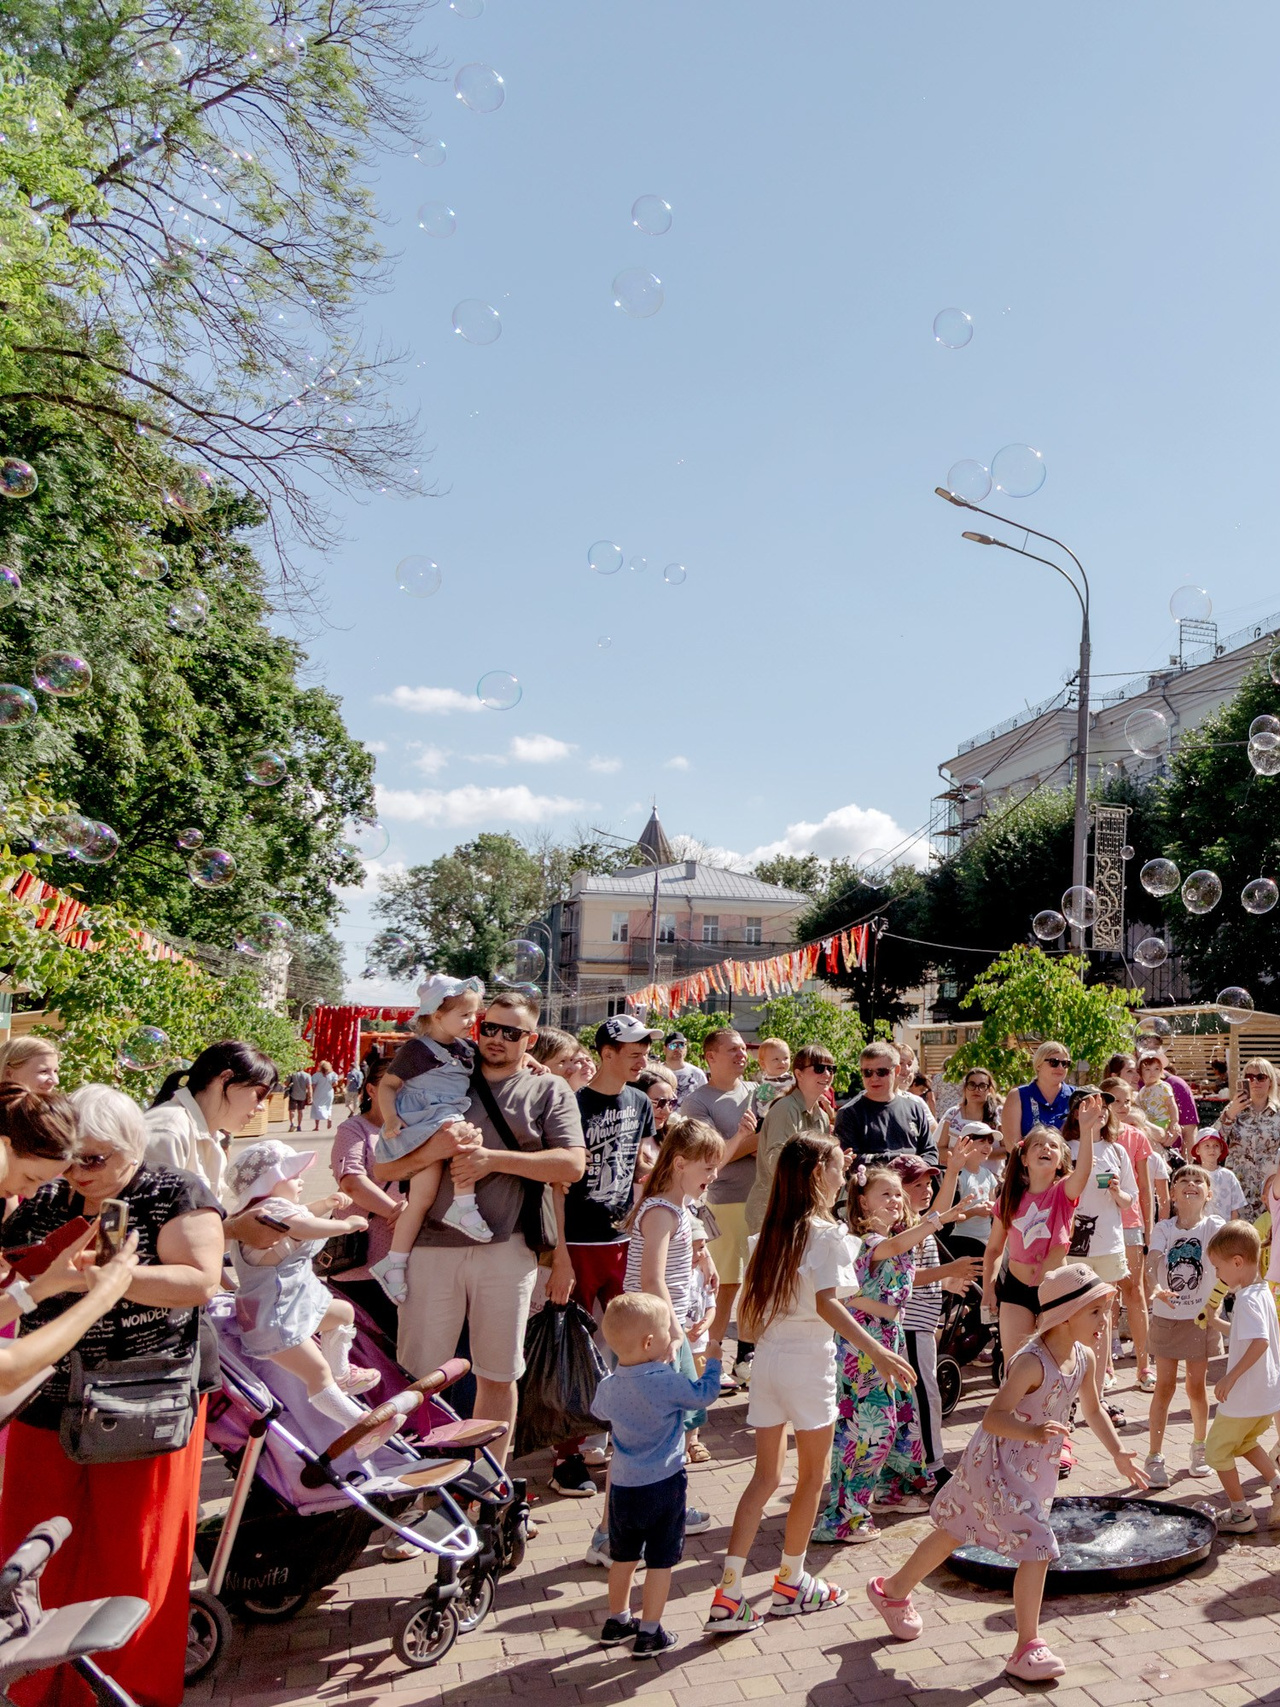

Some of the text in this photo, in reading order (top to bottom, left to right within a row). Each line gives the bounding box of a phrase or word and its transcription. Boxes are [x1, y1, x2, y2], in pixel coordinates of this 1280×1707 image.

[599, 1106, 638, 1127] Atlantic
[586, 1119, 640, 1146] Navigation
[121, 1308, 170, 1328] WONDER
[225, 1566, 289, 1591] Nuovita
